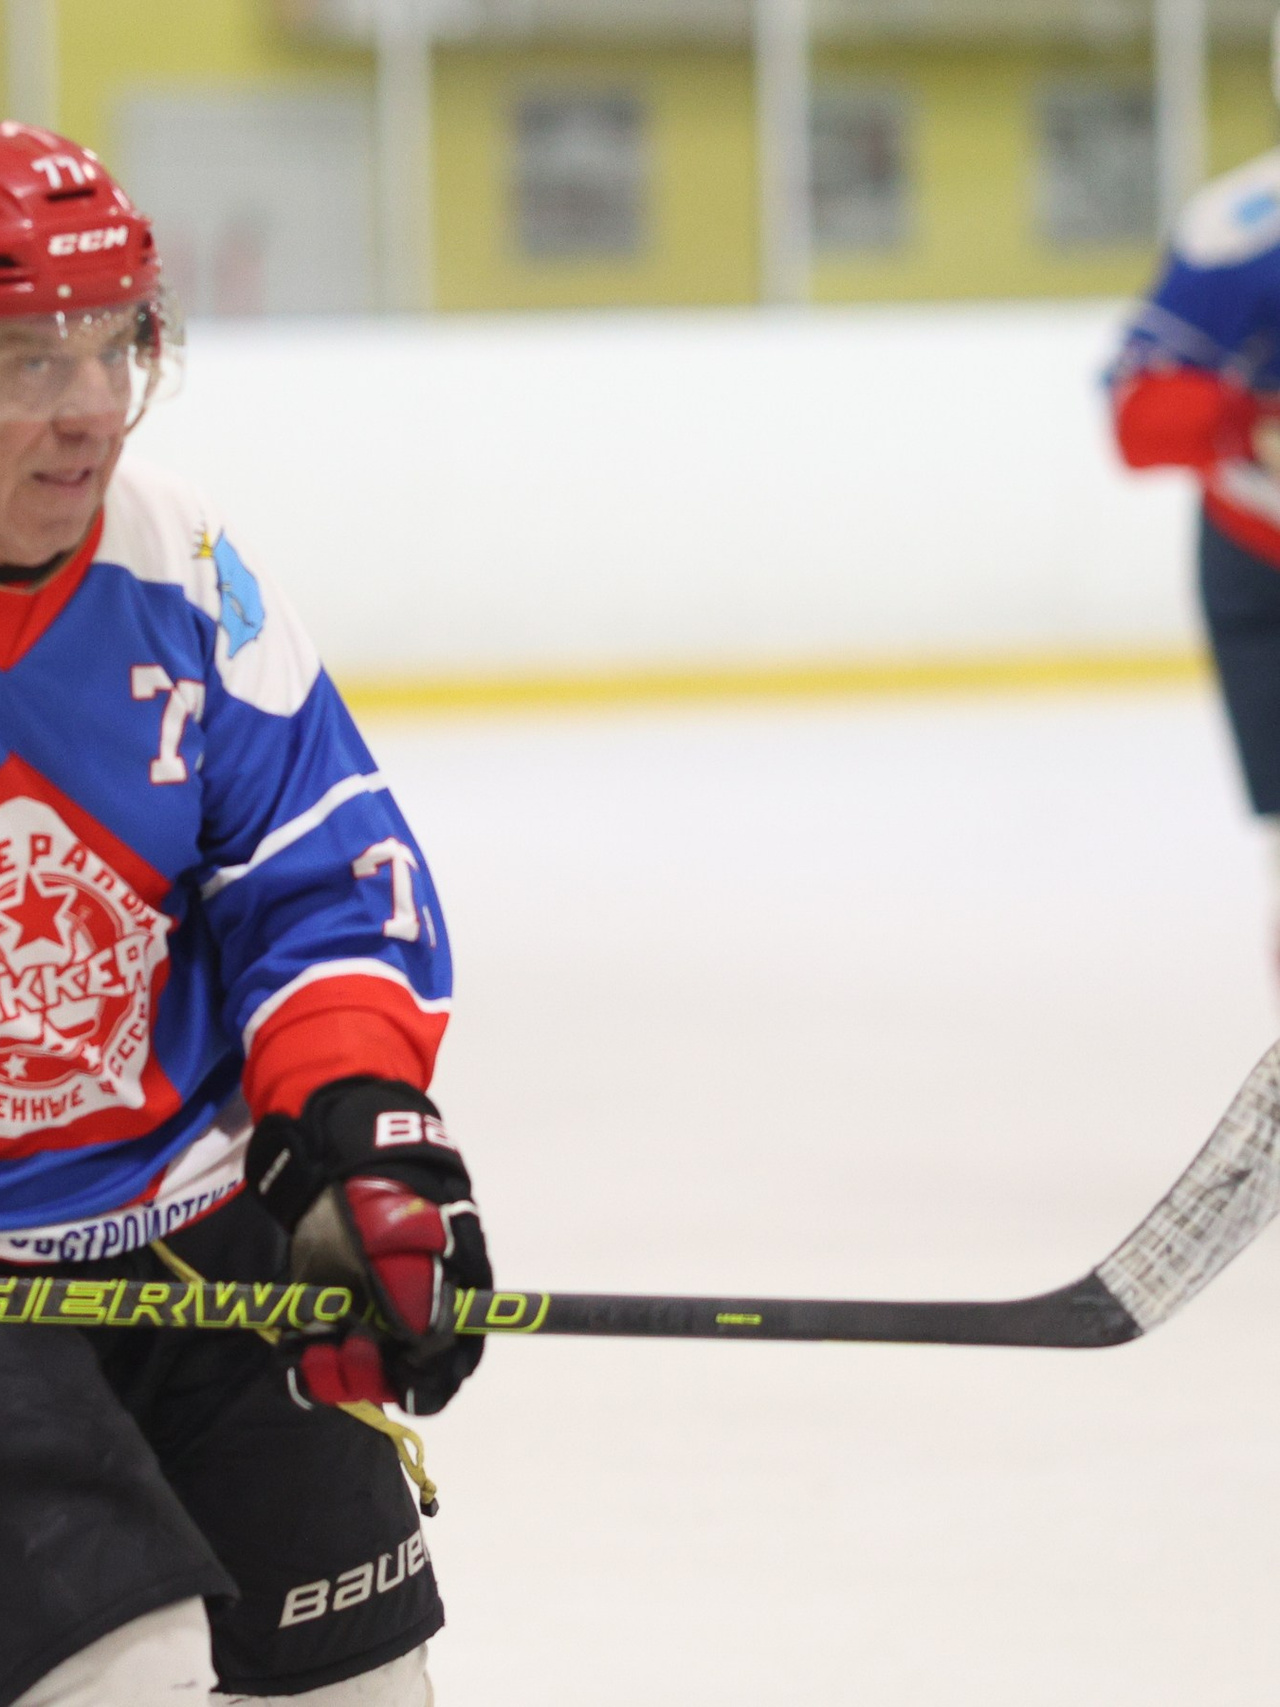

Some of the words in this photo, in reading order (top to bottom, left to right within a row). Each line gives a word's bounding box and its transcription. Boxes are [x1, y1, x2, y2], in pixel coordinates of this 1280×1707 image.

[30, 156, 85, 189] 77
[47, 225, 129, 256] CCM
[351, 835, 437, 949] 7
